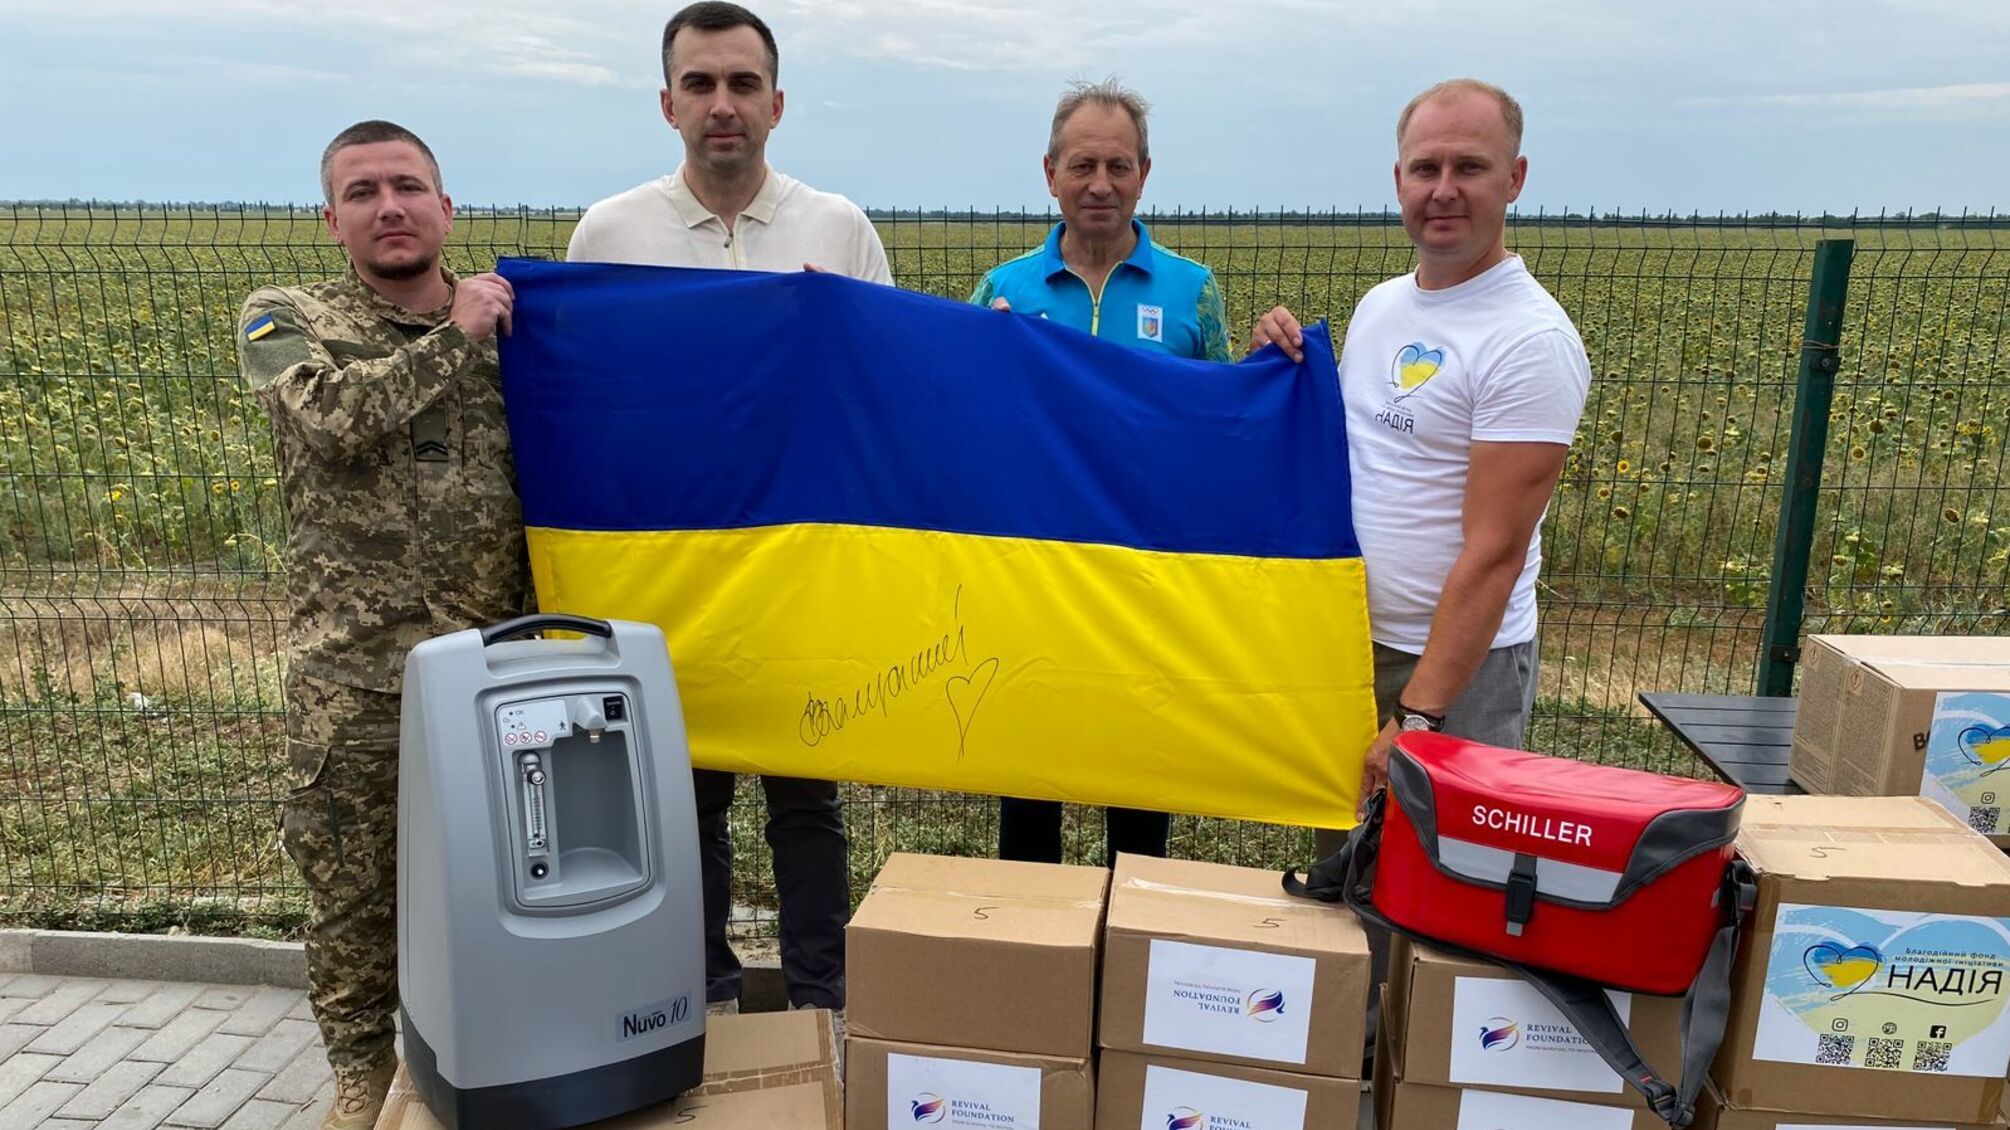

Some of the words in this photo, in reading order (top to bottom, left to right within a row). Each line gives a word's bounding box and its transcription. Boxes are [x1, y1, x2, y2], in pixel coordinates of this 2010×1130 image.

[1472, 804, 1593, 848] SCHILLER
[1887, 963, 2003, 996] НАДІЯ
[1173, 989, 1240, 1004] FOUNDATION
[671, 996, 688, 1024] 10
[1199, 1002, 1239, 1014] REVIVAL
[1527, 1023, 1572, 1034] REVIVAL
[1526, 1034, 1589, 1045] FOUNDATIO
[951, 1100, 991, 1111] REVIVAL
[951, 1109, 1015, 1123] FOUNDATION
[1210, 1115, 1252, 1129] REVIVAL
